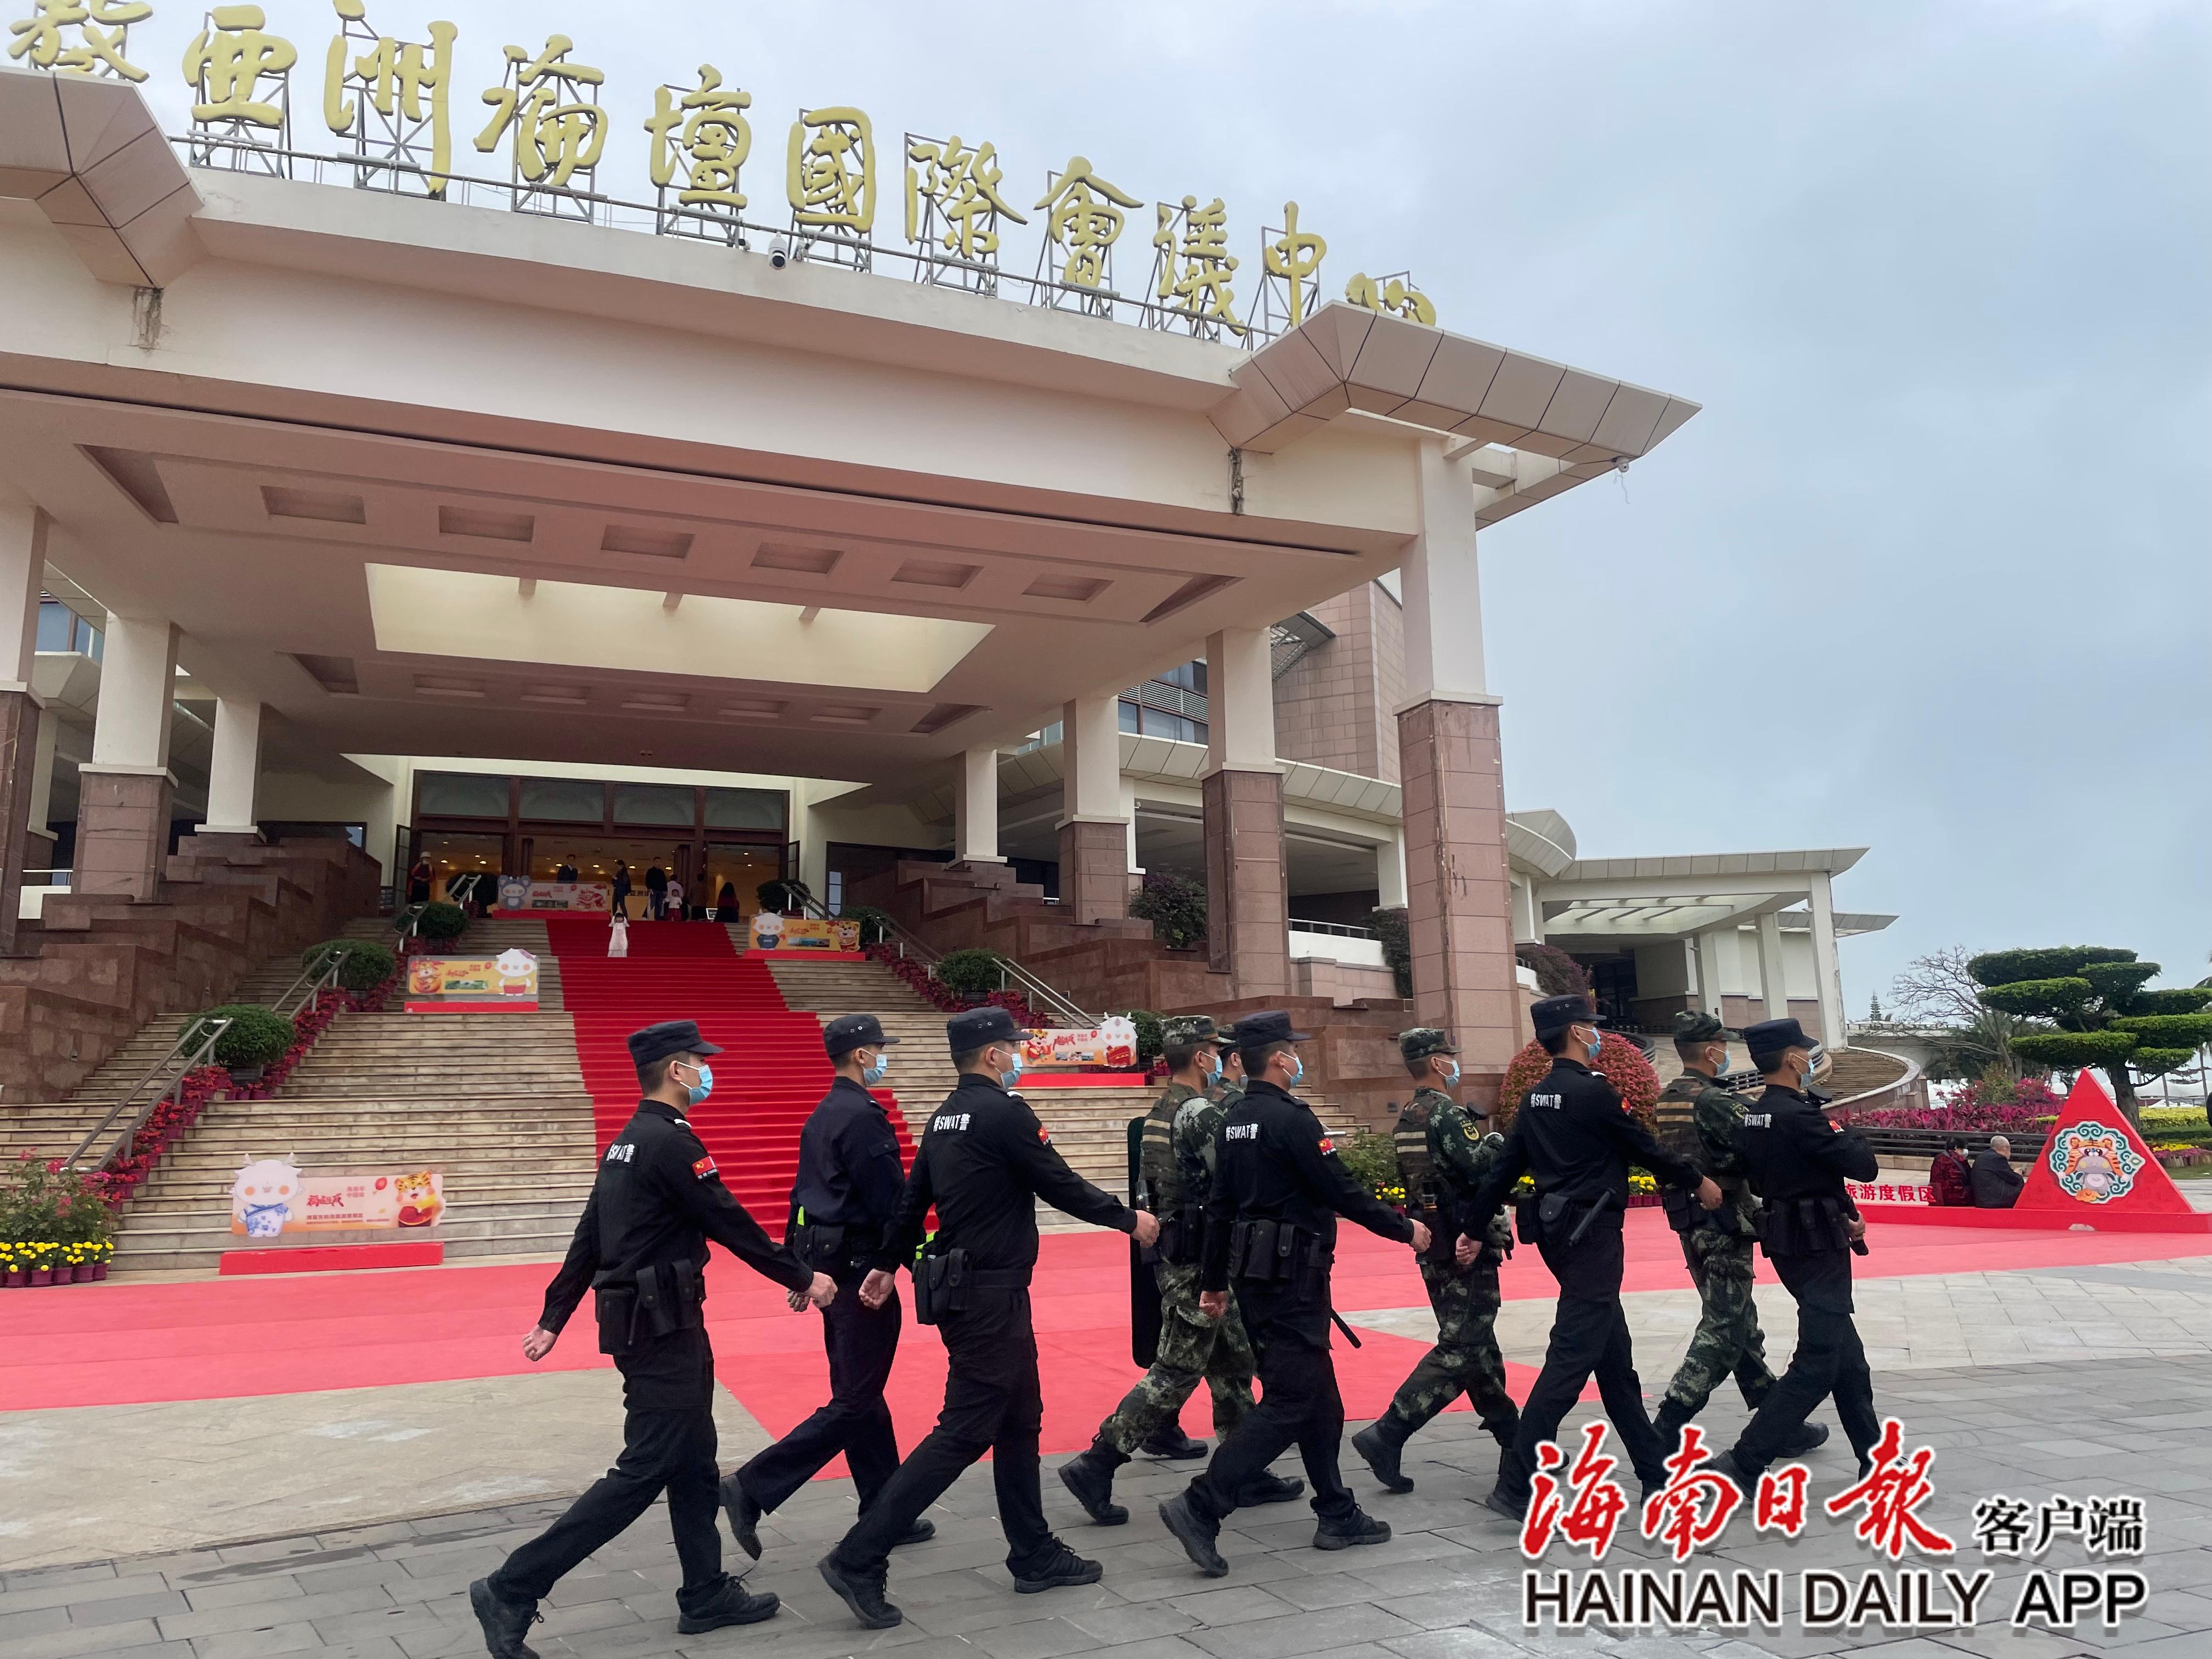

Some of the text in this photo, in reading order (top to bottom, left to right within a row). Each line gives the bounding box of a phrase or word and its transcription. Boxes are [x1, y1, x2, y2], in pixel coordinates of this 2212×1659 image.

[1845, 1183, 1936, 1202] 旅游度假区
